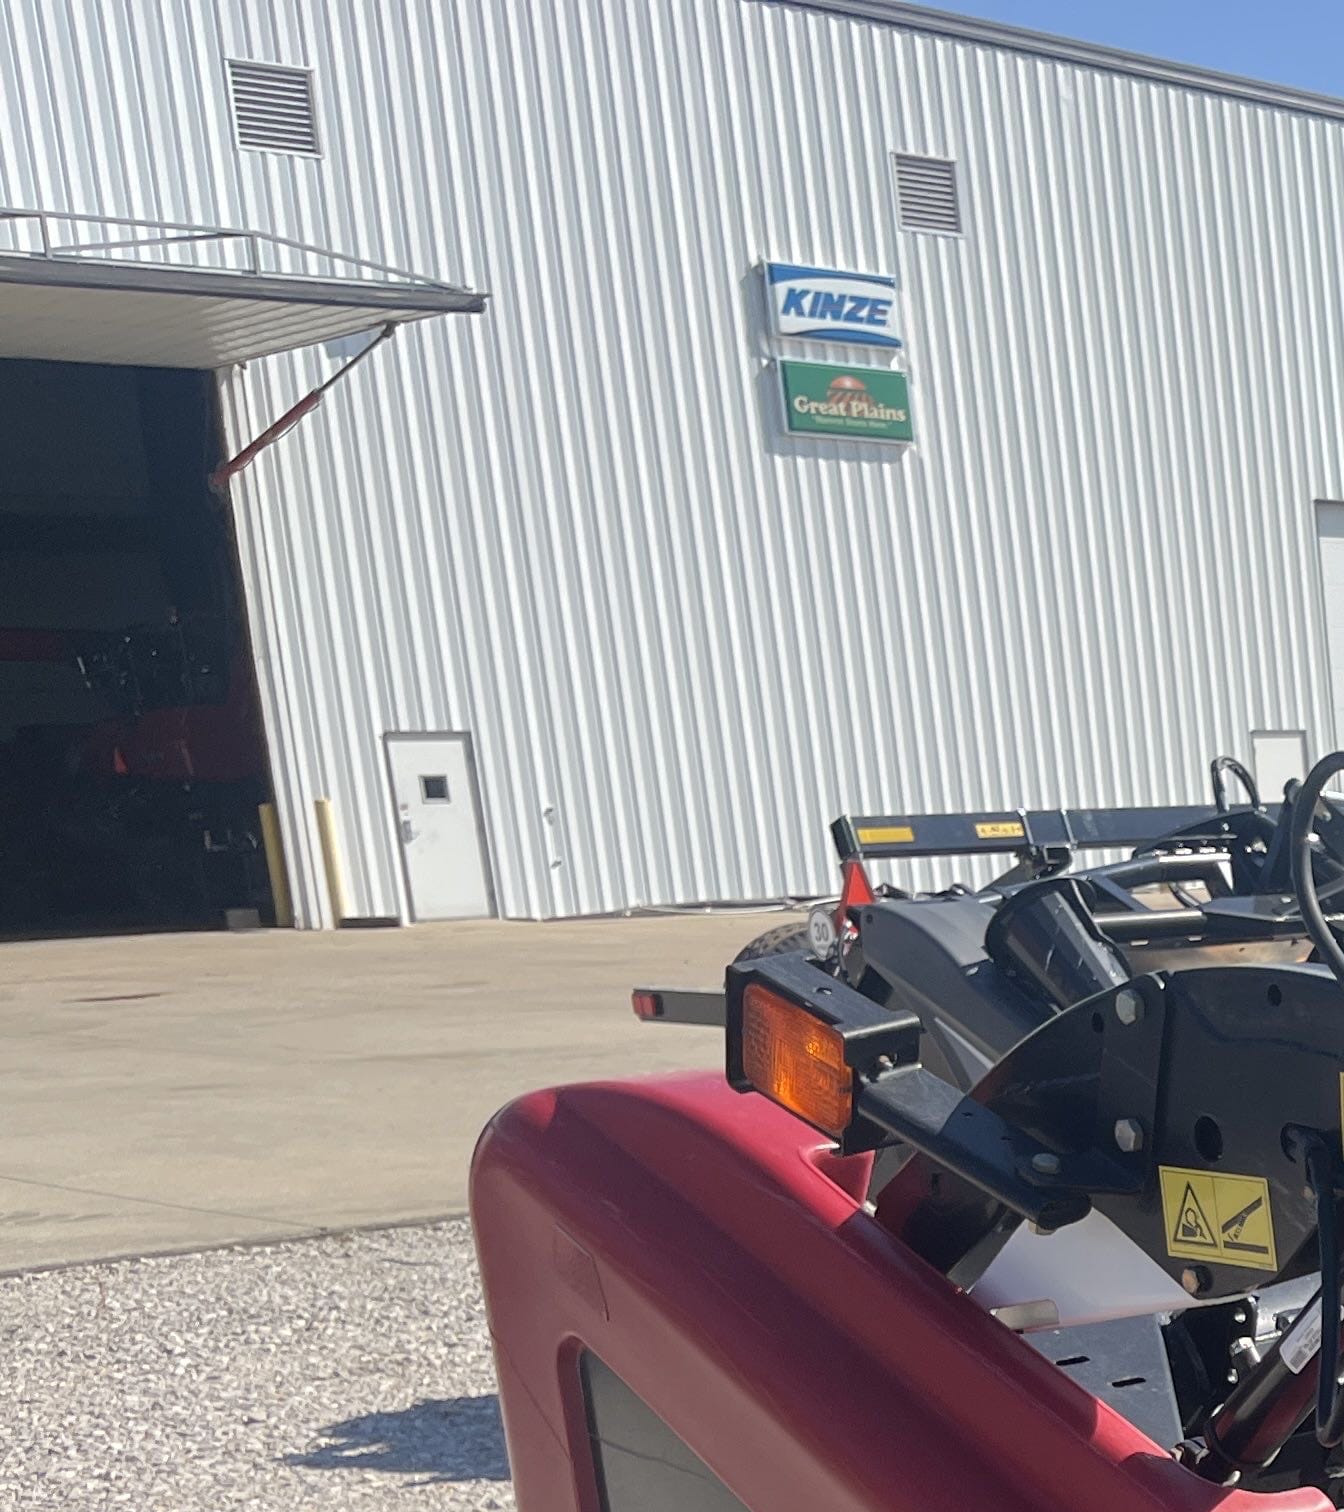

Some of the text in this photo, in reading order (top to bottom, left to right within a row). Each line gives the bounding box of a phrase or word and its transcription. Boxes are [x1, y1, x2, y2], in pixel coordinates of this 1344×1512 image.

[781, 287, 893, 327] KINZE
[794, 395, 847, 417] Great
[849, 401, 906, 422] Plains
[814, 922, 829, 942] 30
